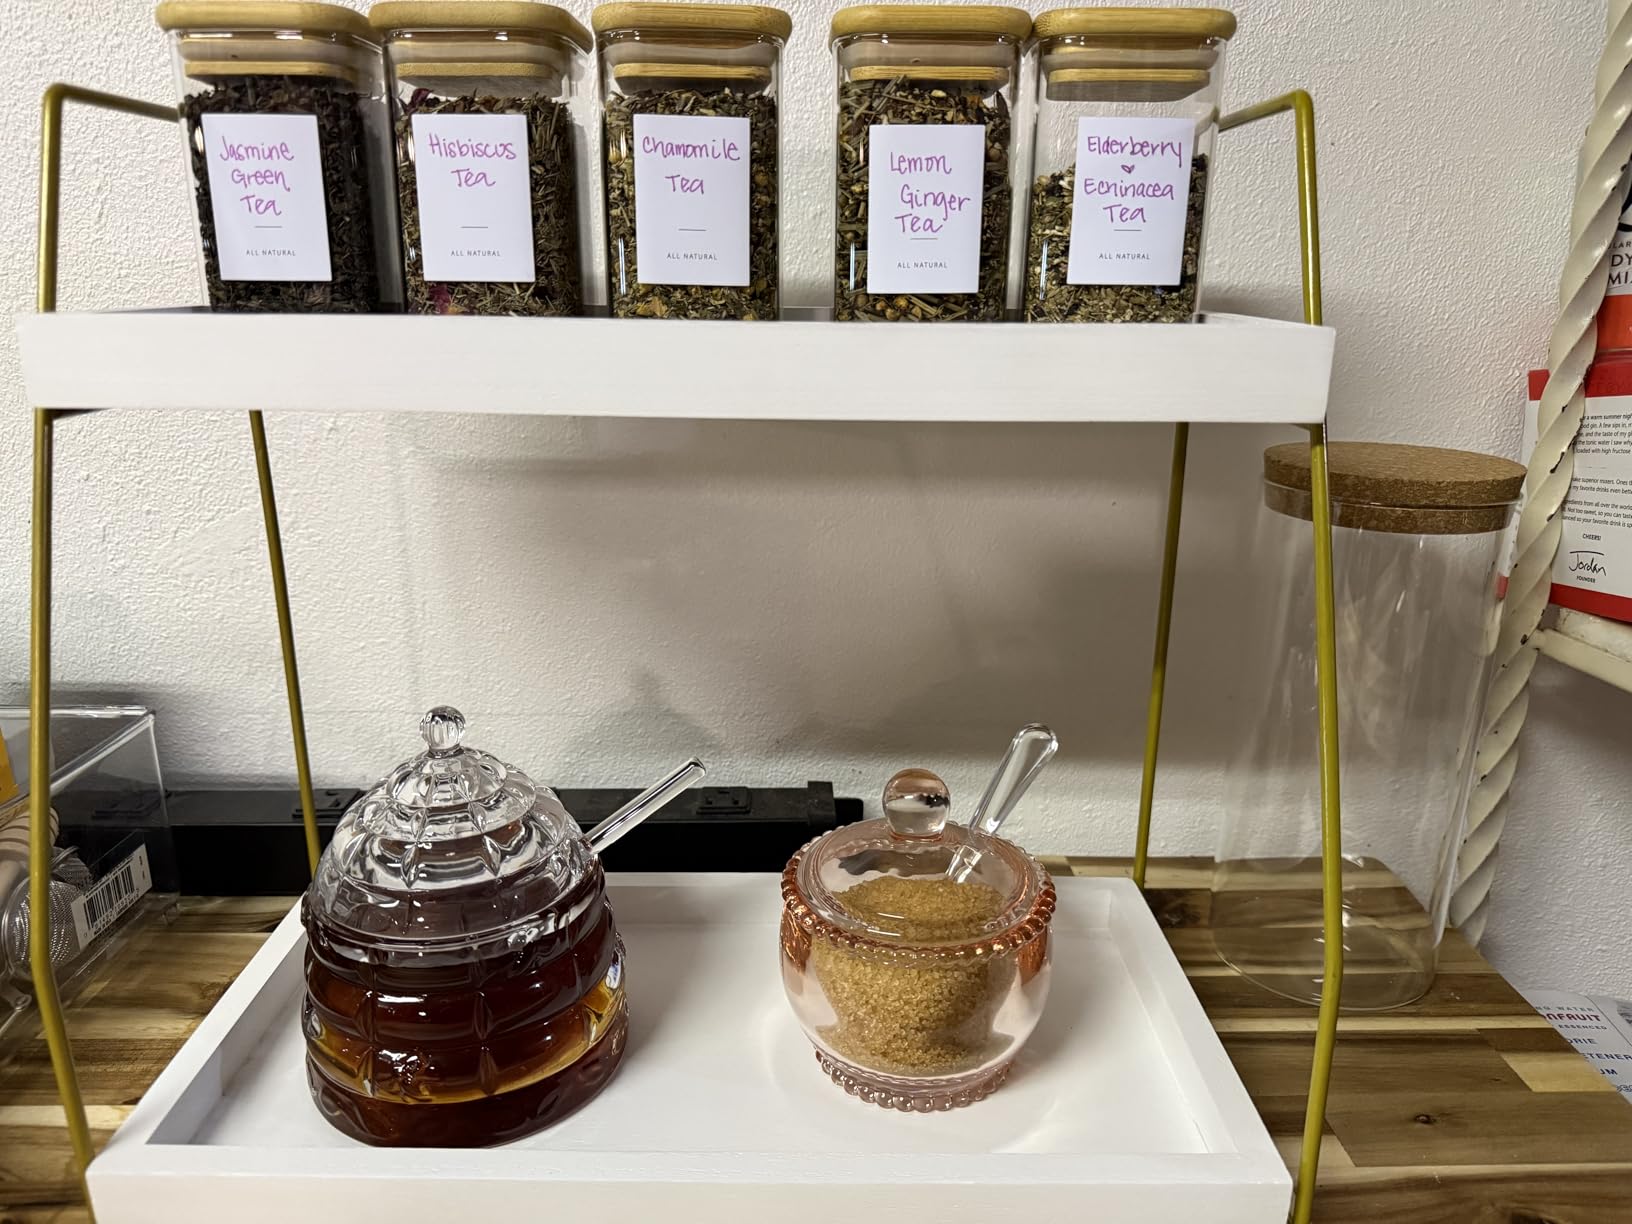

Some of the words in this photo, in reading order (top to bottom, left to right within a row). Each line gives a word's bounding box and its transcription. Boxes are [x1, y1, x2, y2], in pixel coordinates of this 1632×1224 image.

[219, 135, 295, 161] Jasmine
[428, 133, 517, 160] Hisbiscus
[642, 135, 741, 161] Chamomile
[1087, 136, 1182, 168] Elderberry
[890, 151, 952, 175] Lemon
[231, 168, 291, 192] Green
[451, 168, 496, 187] Tea
[665, 174, 705, 195] Tea
[1084, 178, 1174, 200] Echinacea
[240, 194, 282, 216] Tea
[900, 183, 971, 221] Ginger
[1103, 203, 1146, 223] Tea
[894, 214, 943, 233] Tea
[262, 249, 297, 257] NATURAL
[667, 252, 681, 260] ALL
[683, 252, 718, 261] NATURAL
[897, 261, 911, 269] ALL
[913, 261, 948, 269] NATURAL
[1608, 271, 1632, 285] MI
[1569, 551, 1606, 576] Jordan
[1576, 575, 1596, 583] FOUNDER
